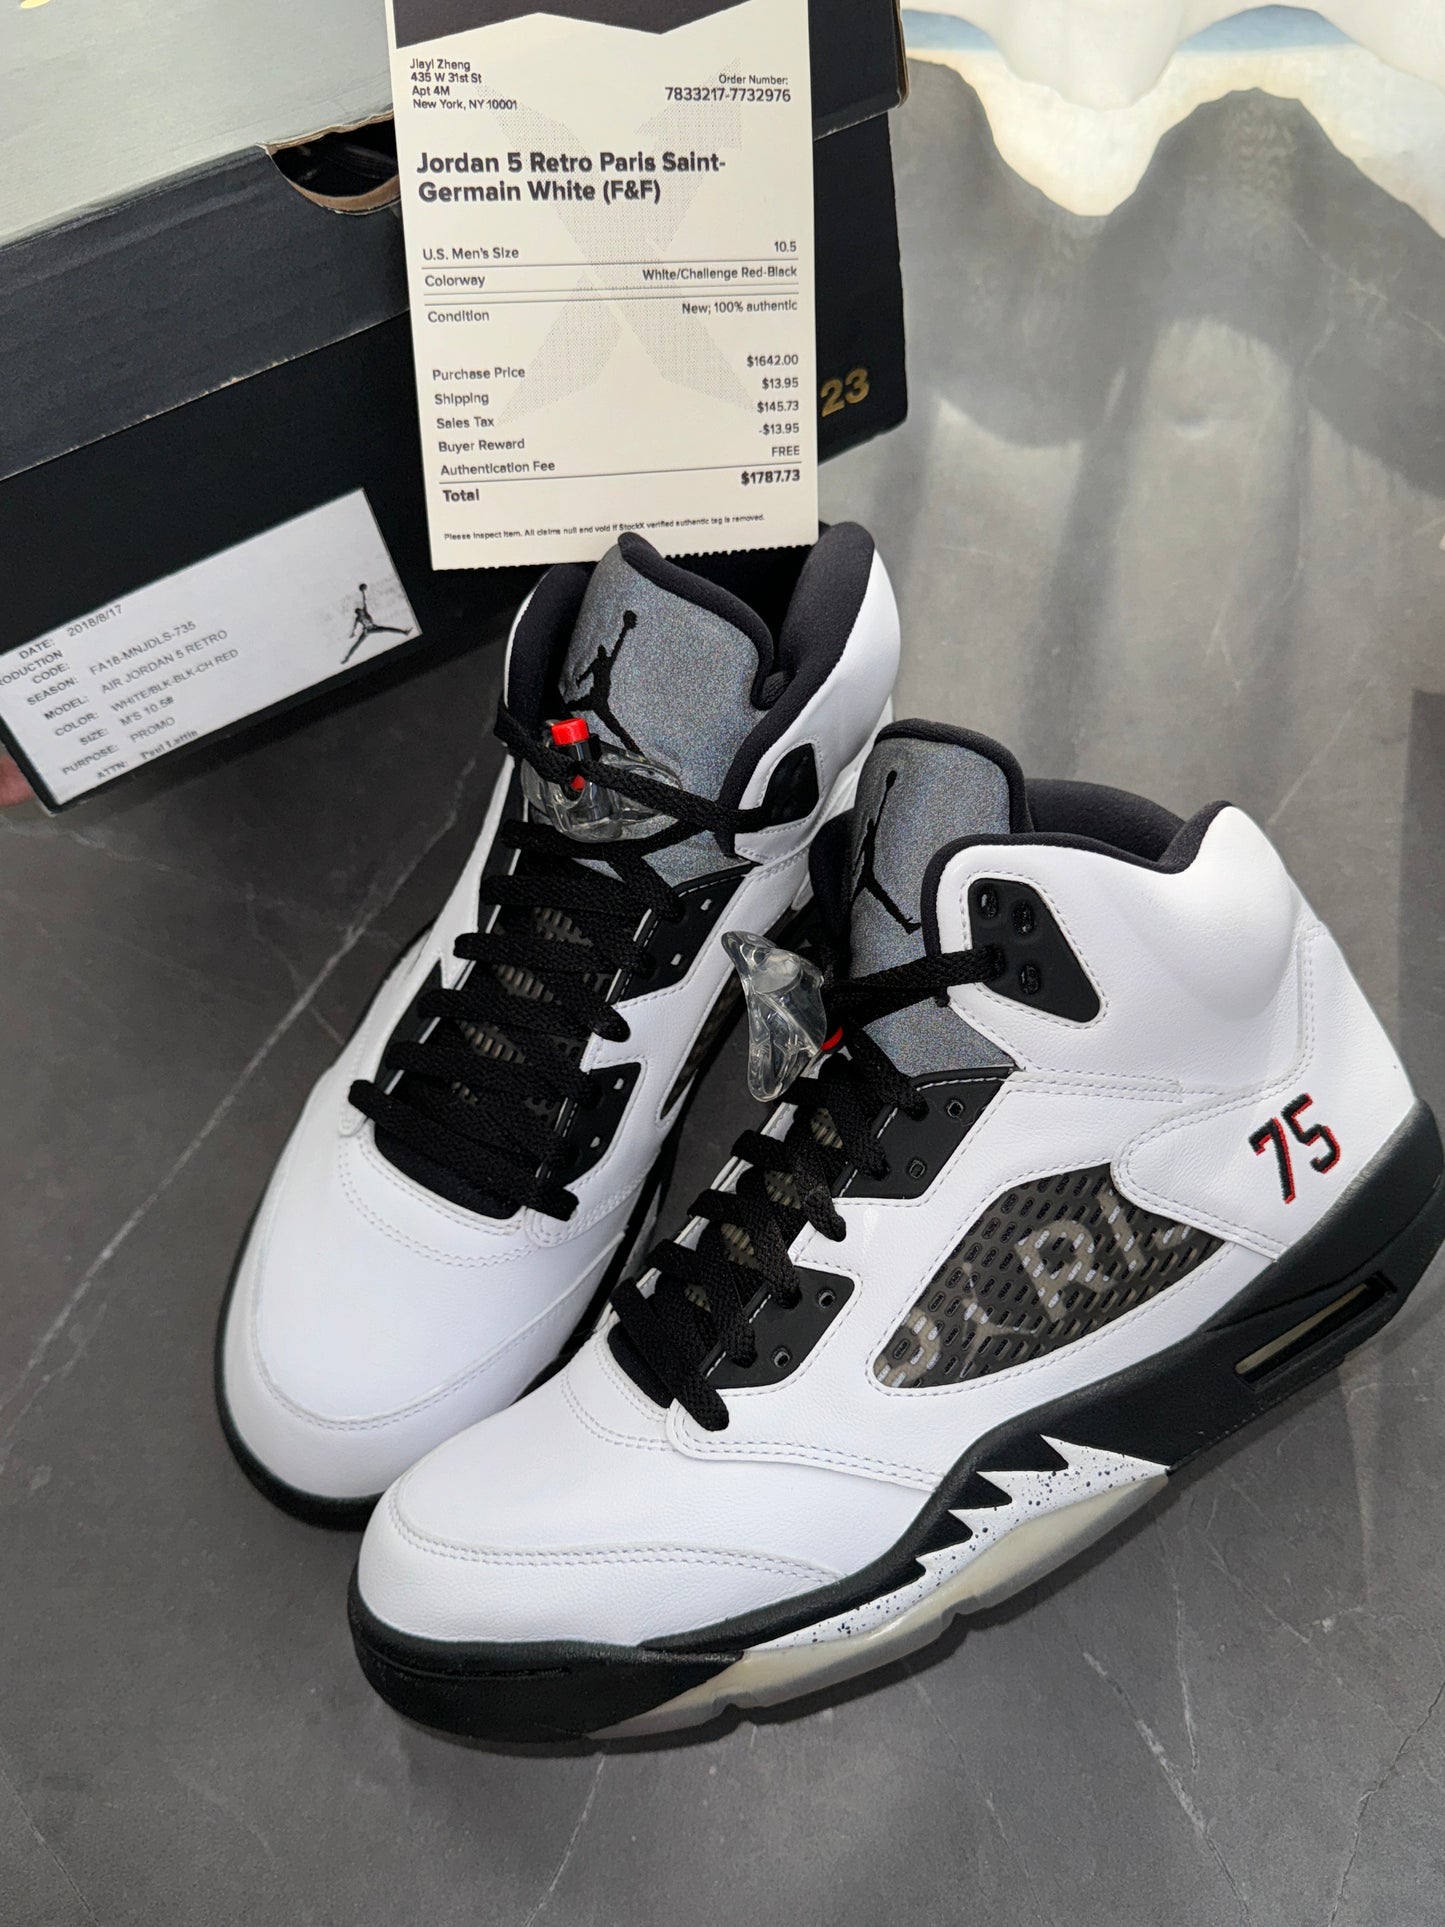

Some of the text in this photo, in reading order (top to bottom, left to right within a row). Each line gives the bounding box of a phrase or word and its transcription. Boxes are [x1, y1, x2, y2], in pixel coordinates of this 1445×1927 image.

[437, 59, 471, 72] Zheng
[411, 72, 482, 84] 435 W 31st St
[719, 73, 789, 85] Order Number:
[412, 85, 450, 98] Apt 4M
[665, 87, 791, 102] 7833217-7732976
[413, 98, 517, 110] New York, NY 10001
[417, 151, 726, 173] Jordan 5 Retro Paris Saint-
[418, 179, 661, 205] Germain White (F&F)
[423, 246, 519, 260] U.S. Men's Size
[774, 240, 797, 252] 10.5
[643, 266, 797, 281] White/Challenge Red-Black
[424, 275, 485, 288] Colorway
[682, 300, 798, 315] New; 100% authentic
[427, 310, 489, 323] Condition
[746, 354, 799, 368] $1642.00
[432, 367, 525, 381] Purchase Price
[762, 377, 799, 390] $13.95
[434, 392, 489, 407] Shipping
[820, 367, 870, 417] 23
[757, 400, 799, 414] $145.73
[436, 416, 494, 429] Sales Tax
[758, 422, 800, 436] -$13.95
[438, 438, 525, 454] Buyer Reward
[771, 445, 800, 457] FREE
[440, 460, 555, 476] Authentication Fee
[741, 469, 801, 486] $1787.73
[443, 488, 480, 502] Total
[444, 532, 471, 541] Please
[473, 531, 502, 541] inspect
[503, 530, 523, 538] item.
[537, 528, 561, 536] claims
[563, 526, 577, 534] null
[579, 526, 593, 534] and
[619, 522, 645, 531] StockX
[647, 521, 674, 529] verified
[676, 519, 709, 527] authentic
[711, 517, 723, 525] tag
[732, 514, 764, 522] removed.
[19, 604, 122, 659] DATE: 2018/8/17
[27, 620, 197, 705] SEASON: FA18-MNJDLS-735
[33, 662, 70, 684] CODE:
[44, 629, 228, 720] MODEL: AIR JORDAN 5 RETRO
[55, 712, 100, 736] COLOR:
[215, 649, 239, 665] RED
[80, 727, 109, 746] SIZE:
[62, 716, 176, 776] PURPOSE: PROMO
[96, 760, 130, 779] ATTN:
[1247, 1092, 1341, 1204] 75
